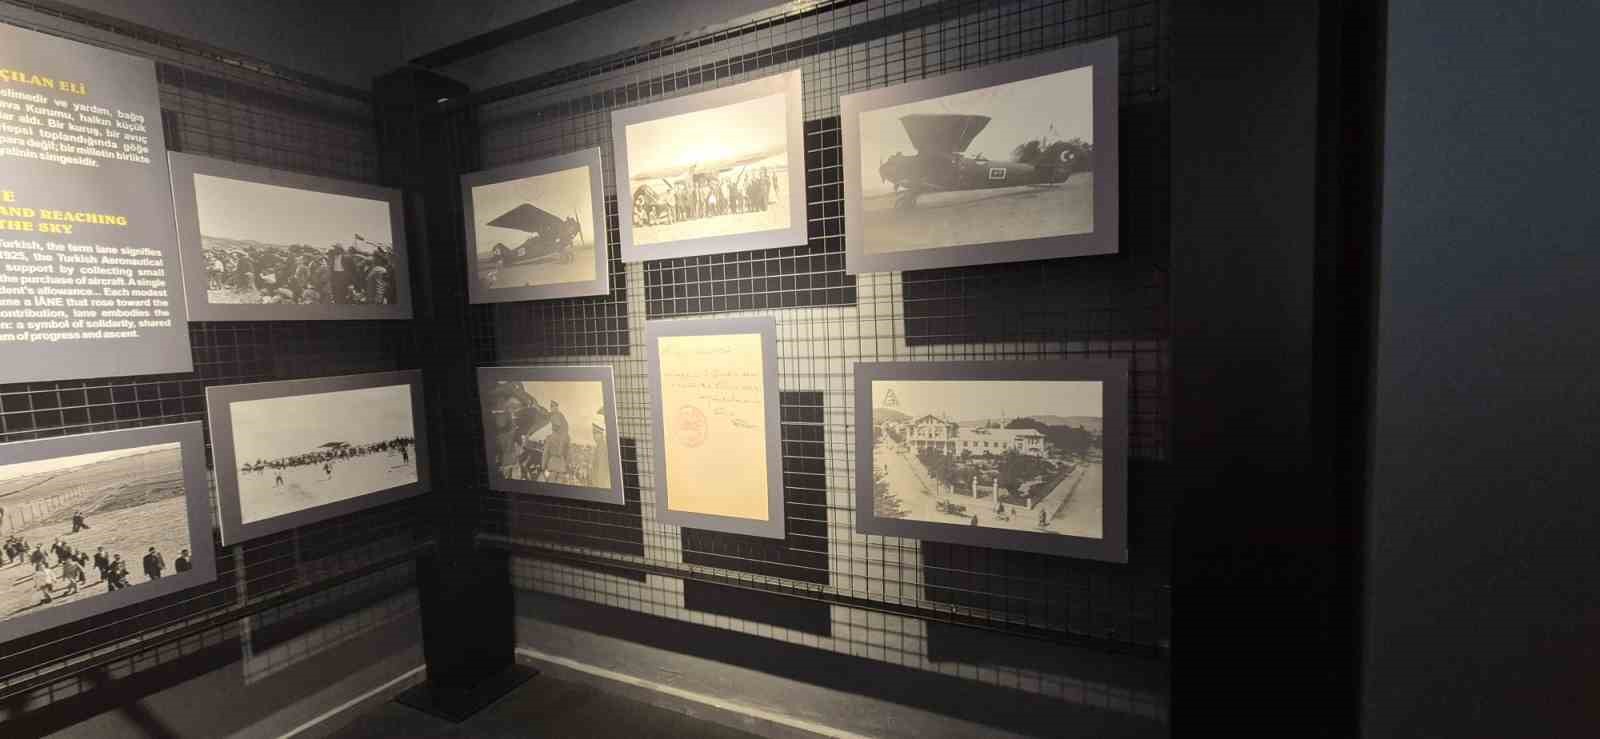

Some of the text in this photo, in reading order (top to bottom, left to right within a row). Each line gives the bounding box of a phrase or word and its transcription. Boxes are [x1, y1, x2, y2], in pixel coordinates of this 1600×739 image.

[48, 119, 64, 129] Bir
[106, 129, 120, 138] bir
[40, 208, 128, 226] REACHING
[38, 223, 73, 235] SKY
[46, 241, 65, 251] the
[33, 253, 53, 262] the
[58, 253, 97, 264] Turkish
[101, 256, 163, 267] Aeronautical
[5, 264, 164, 277] support by collecting small
[20, 276, 74, 286] purchase
[75, 276, 87, 285] of
[128, 278, 136, 286] A
[26, 319, 70, 331] symbol
